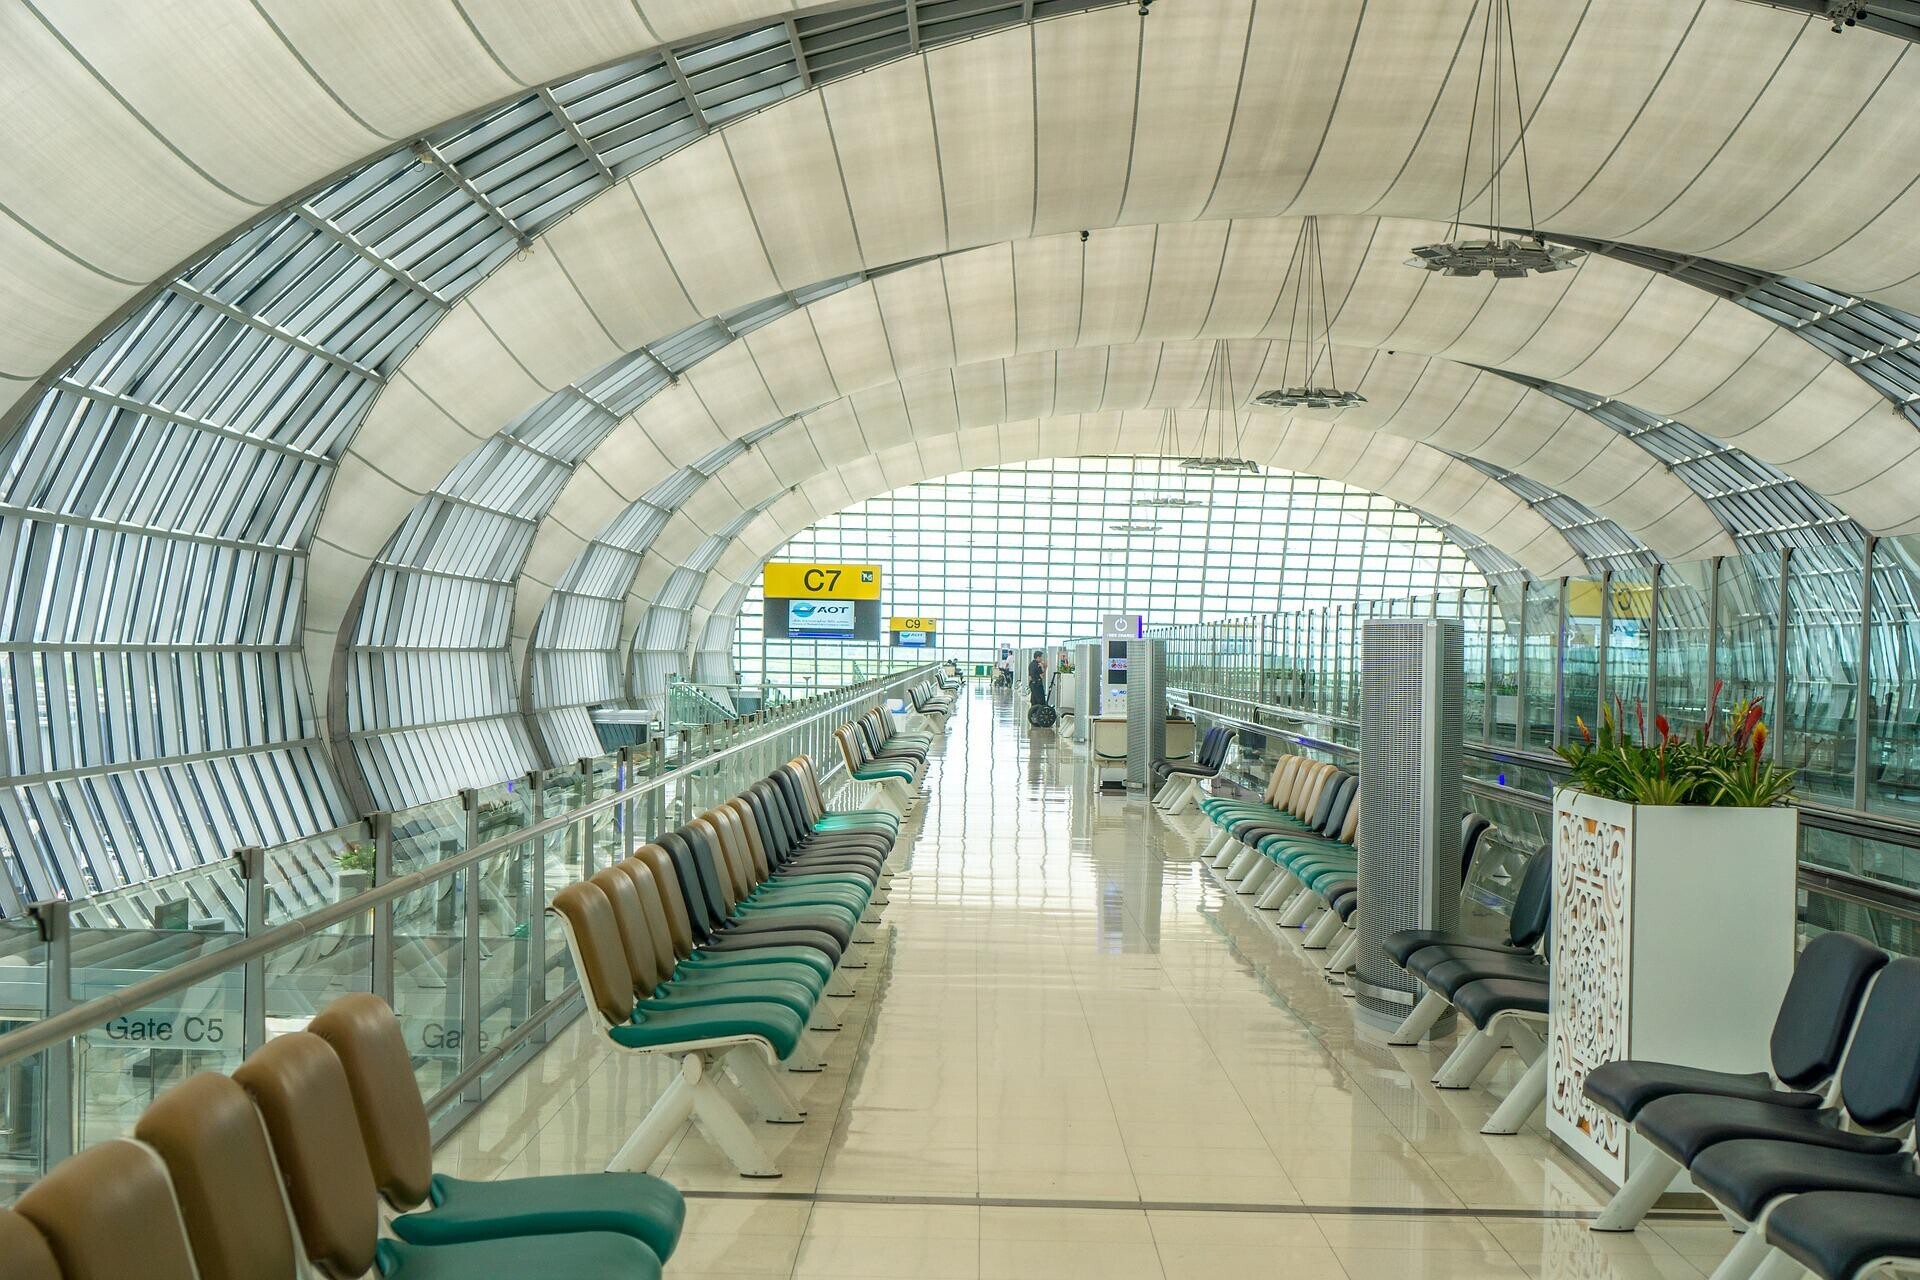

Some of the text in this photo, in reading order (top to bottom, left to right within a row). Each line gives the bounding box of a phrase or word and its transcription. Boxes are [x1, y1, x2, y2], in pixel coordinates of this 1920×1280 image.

[804, 568, 842, 592] C7
[817, 606, 849, 614] AOT
[905, 618, 921, 629] C9
[105, 1016, 224, 1042] Gate C5
[423, 1023, 489, 1049] Gae
